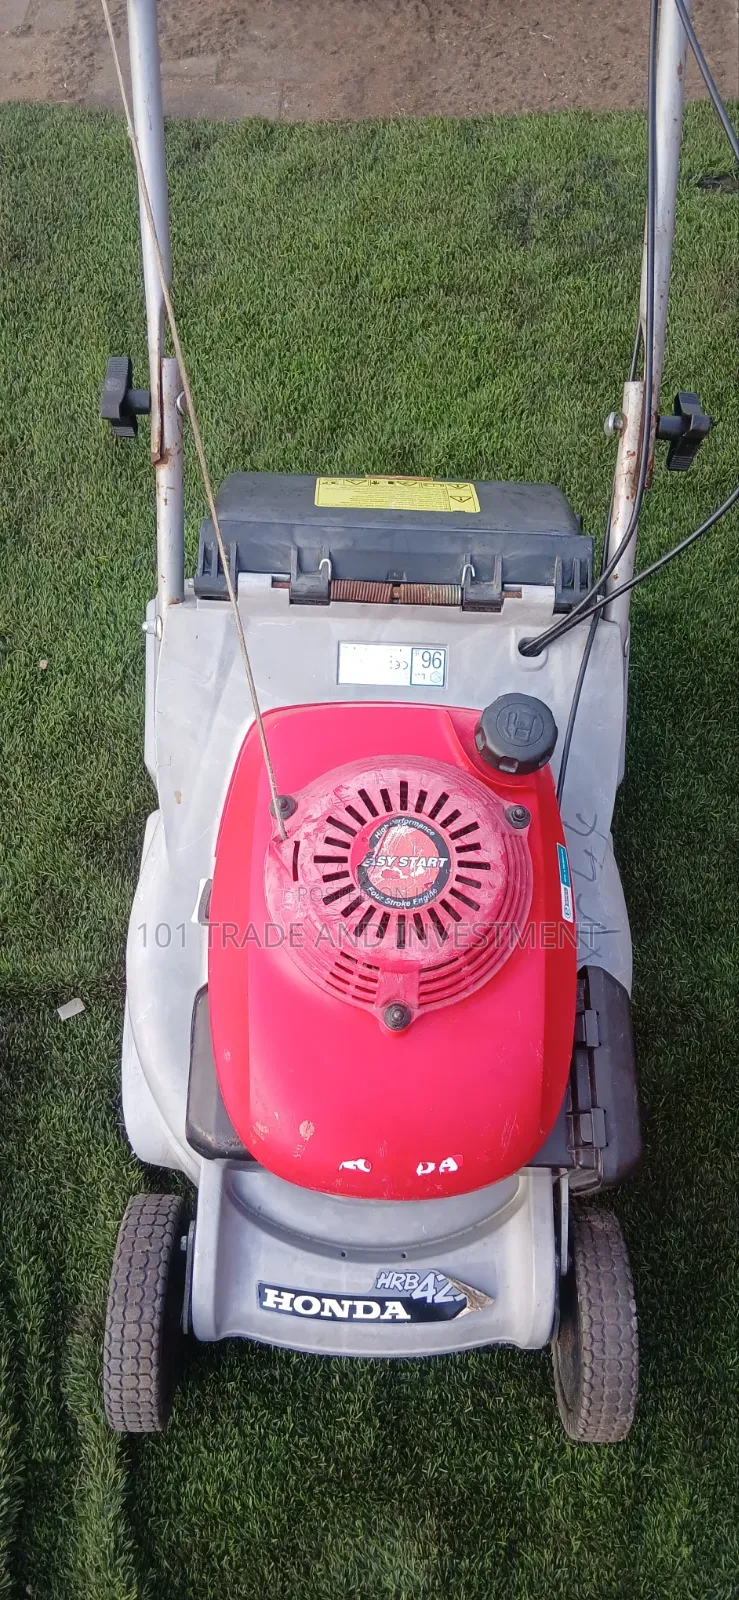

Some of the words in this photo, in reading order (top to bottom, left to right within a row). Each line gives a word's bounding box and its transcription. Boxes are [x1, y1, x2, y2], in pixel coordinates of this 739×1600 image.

[421, 650, 442, 669] 96
[374, 823, 389, 839] High
[390, 818, 436, 836] erformance
[398, 856, 449, 868] START
[366, 886, 384, 901] Four
[384, 897, 411, 907] Stroke
[262, 1288, 411, 1320] HONDA
